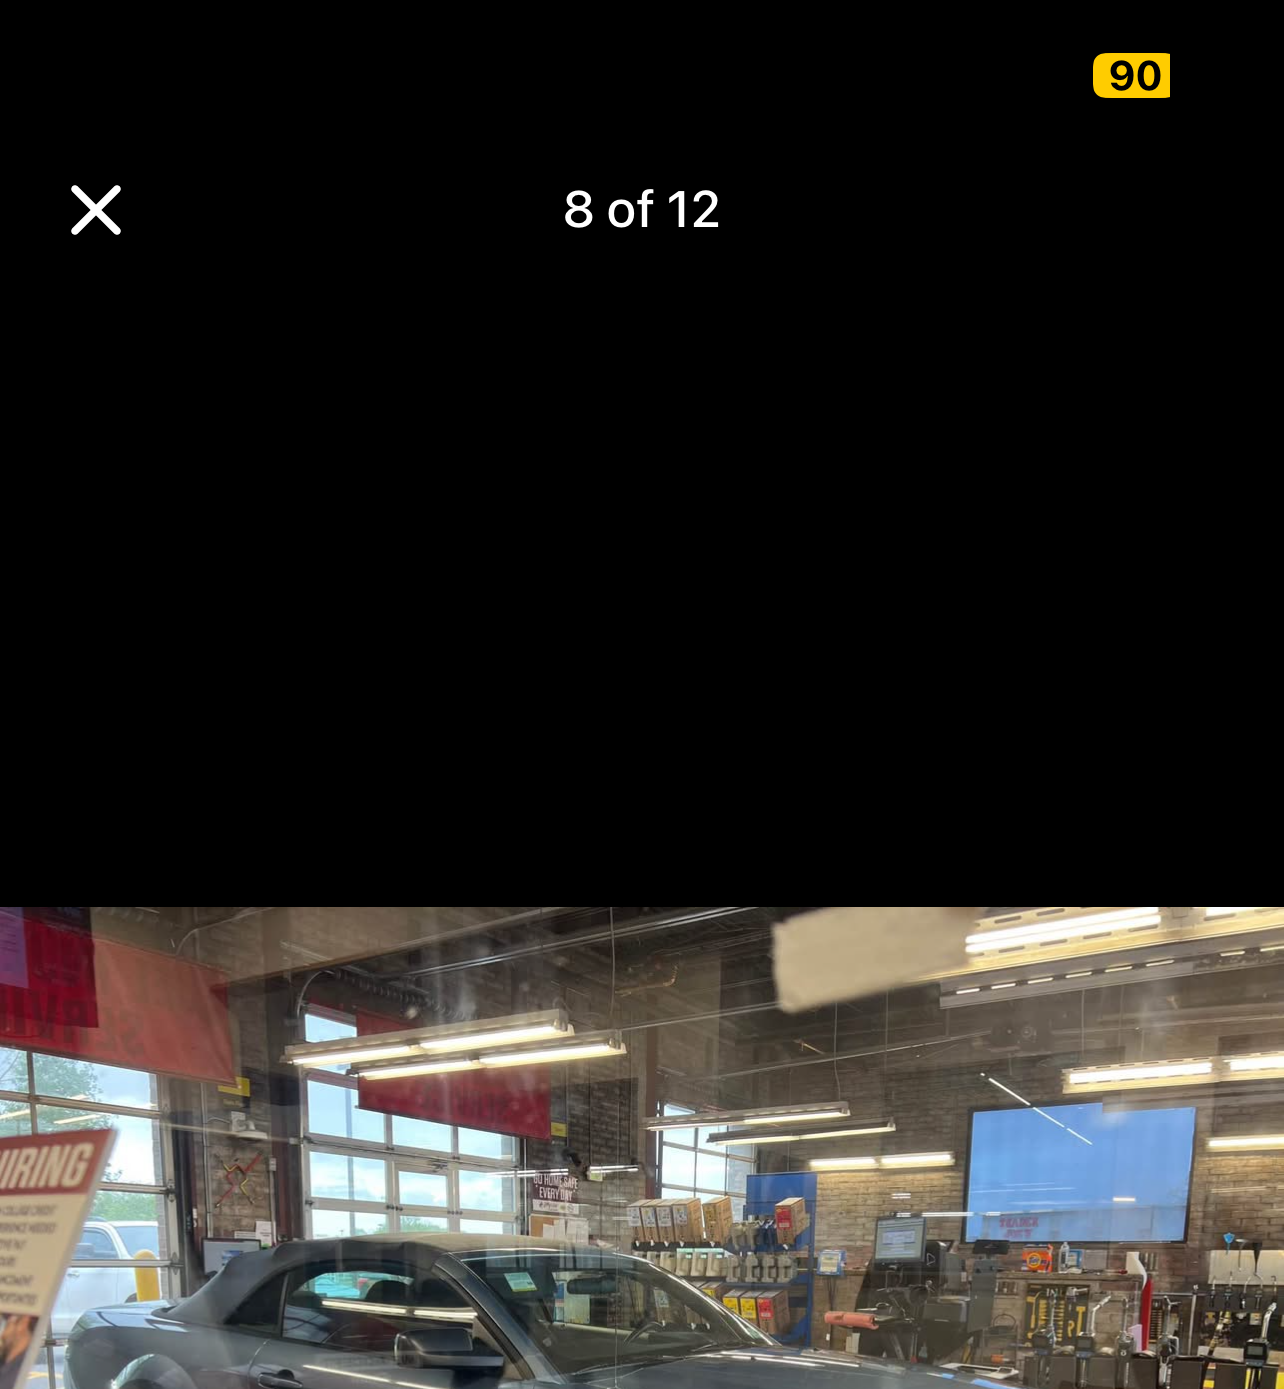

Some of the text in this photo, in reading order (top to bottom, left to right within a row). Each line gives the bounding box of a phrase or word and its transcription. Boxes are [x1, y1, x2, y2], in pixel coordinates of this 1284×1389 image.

[533, 1173, 579, 1189] GO HOME SAFE
[539, 1187, 573, 1202] EVERY DAY
